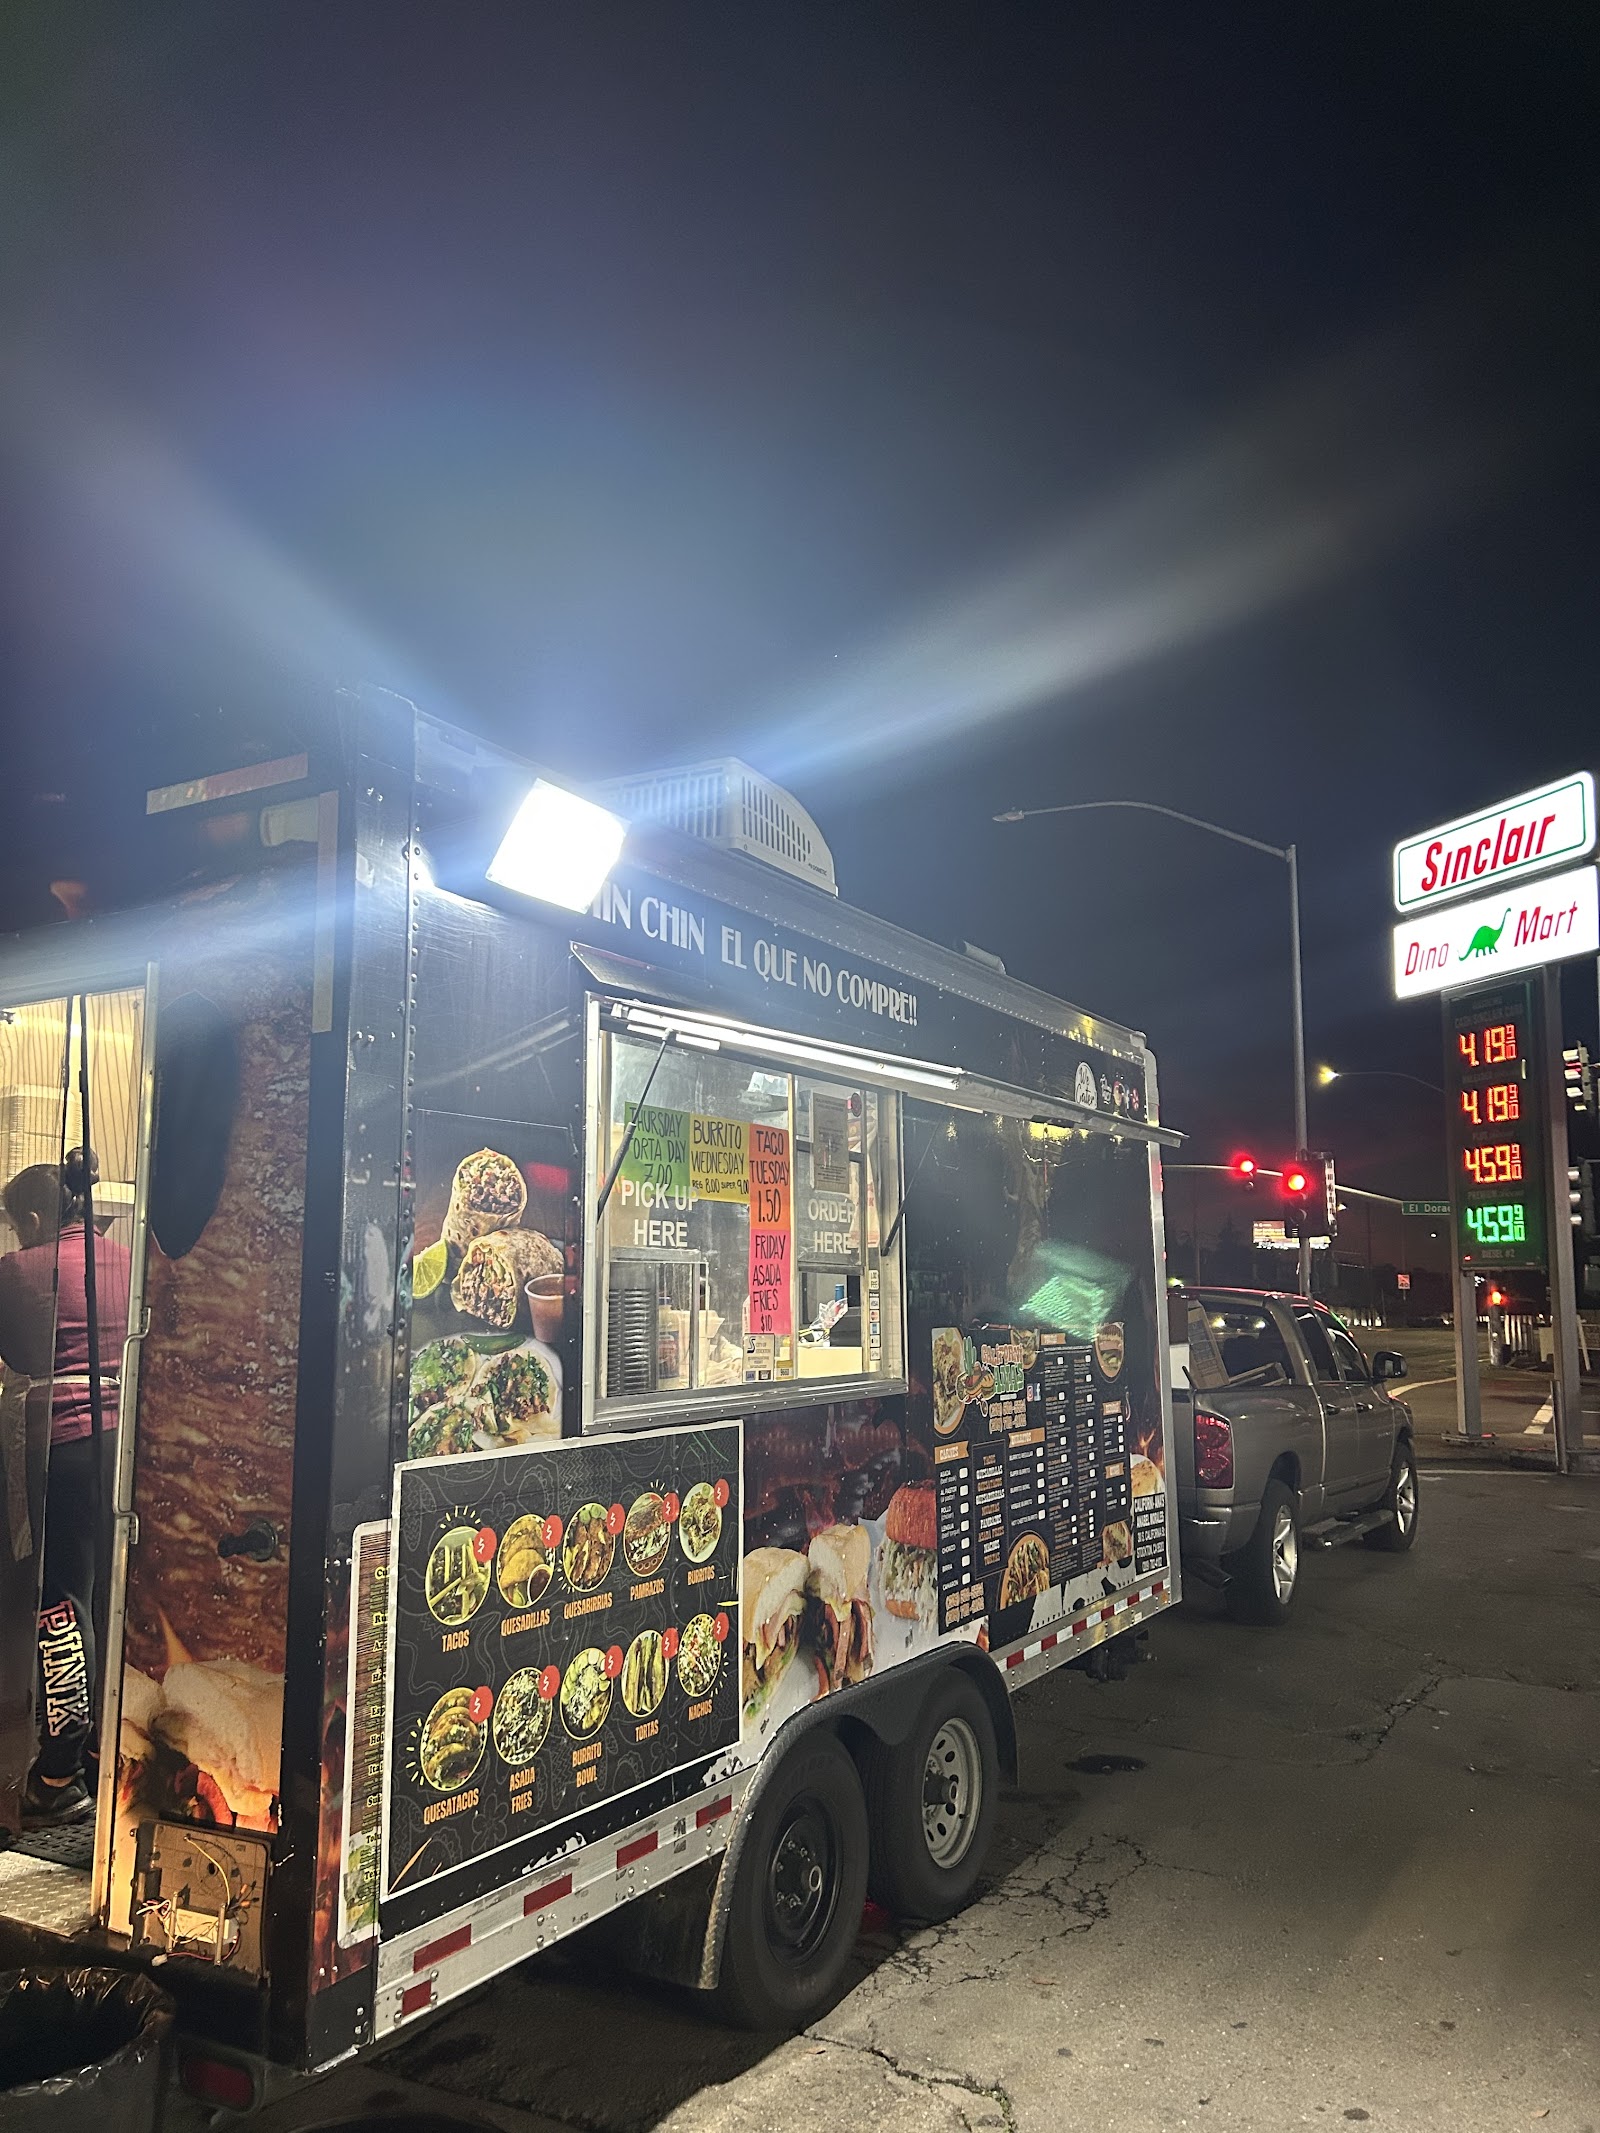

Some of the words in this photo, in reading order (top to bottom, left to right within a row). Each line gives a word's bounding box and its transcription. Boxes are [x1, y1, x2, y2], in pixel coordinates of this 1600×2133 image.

[1421, 814, 1556, 891] Sinclair
[1405, 942, 1449, 976] Dino
[1514, 901, 1578, 947] Mart
[592, 879, 631, 929] IN
[640, 896, 705, 955] CHIN
[721, 925, 747, 970] EL
[754, 940, 797, 987] QUE
[803, 955, 832, 998] NO
[837, 969, 918, 1027] COMPRE!!
[693, 1119, 742, 1150] BURRITO
[756, 1130, 784, 1156] TACO
[632, 1138, 662, 1161] ORTA
[667, 1140, 687, 1163] DAY
[691, 1150, 745, 1175] WEDNESDAY
[644, 1163, 673, 1191] 700
[750, 1160, 790, 1186] TUESDAY
[621, 1180, 669, 1209] PICK
[675, 1185, 700, 1211] UP
[757, 1188, 781, 1223] 1.50
[1408, 1203, 1419, 1213] El
[808, 1198, 854, 1224] ORDER
[634, 1219, 688, 1248] HERE
[814, 1231, 852, 1255] HERE
[755, 1234, 786, 1260] FRIDAY
[752, 1264, 782, 1287] ASADA
[753, 1289, 779, 1312] FRIES
[761, 1314, 773, 1333] $10
[687, 1565, 715, 1586] BURRITOS
[630, 1579, 665, 1601] PAMBAZOS
[564, 1593, 613, 1620] QUESABIRRIAS
[501, 1608, 550, 1637] QUESADILLAS
[441, 1629, 470, 1653] TACOS
[38, 1601, 91, 1736] PINK
[688, 1699, 713, 1721] NACHOS
[635, 1720, 659, 1742] TORTAS
[572, 1741, 602, 1768] BURRITO
[509, 1766, 536, 1792] ASADA
[576, 1768, 598, 1788] BOWL
[423, 1788, 479, 1825] QUESATACOS
[511, 1791, 533, 1814] FRIES
